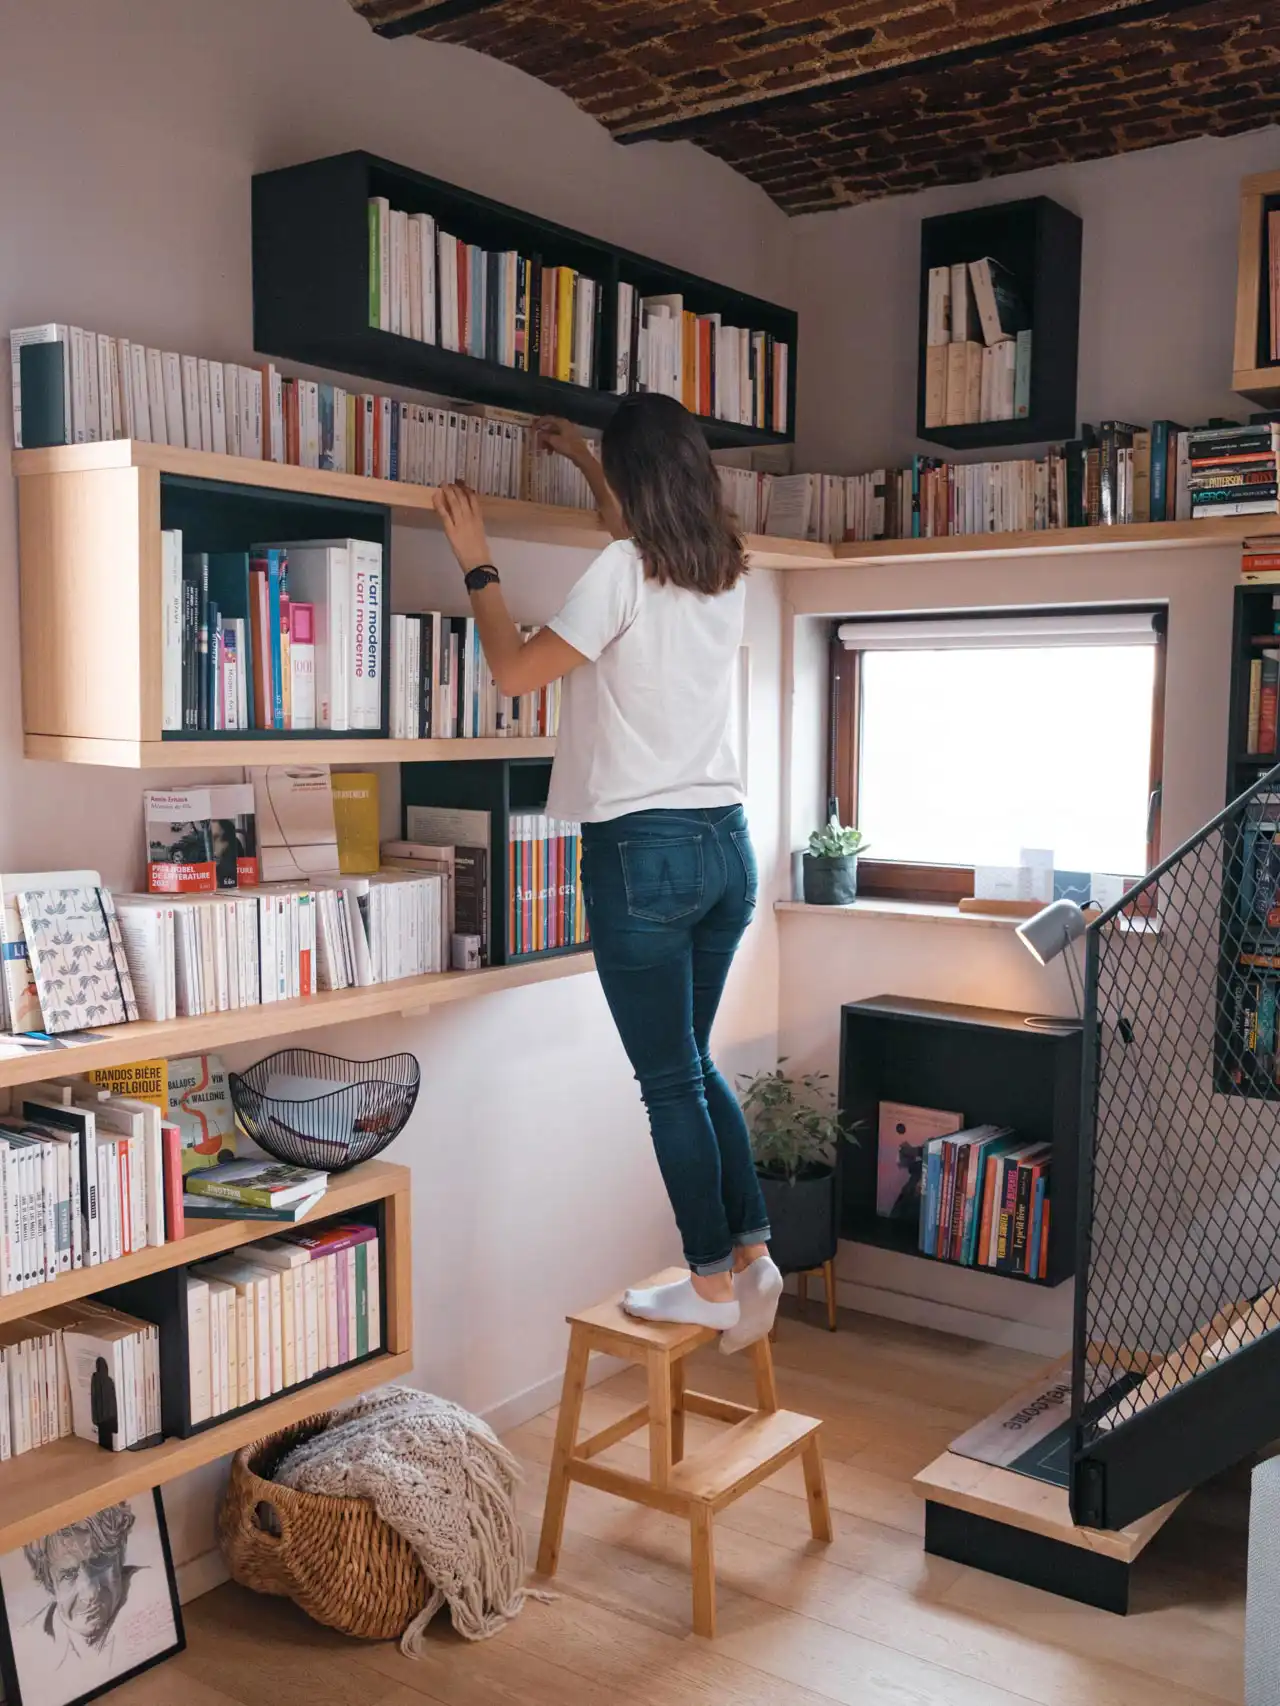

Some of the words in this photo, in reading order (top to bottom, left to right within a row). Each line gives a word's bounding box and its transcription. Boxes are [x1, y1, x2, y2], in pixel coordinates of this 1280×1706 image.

[1192, 490, 1231, 502] MERCY
[355, 572, 366, 605] L'art
[369, 574, 379, 606] L'art
[355, 609, 365, 678] moderne
[367, 609, 378, 679] moderne
[95, 1069, 133, 1081] RANDOS
[134, 1066, 161, 1079] BIÈRE
[113, 1079, 162, 1094] BELGIQUE
[168, 1077, 197, 1090] BALADES
[211, 1075, 224, 1085] VIN
[191, 1091, 225, 1102] WALLONIE
